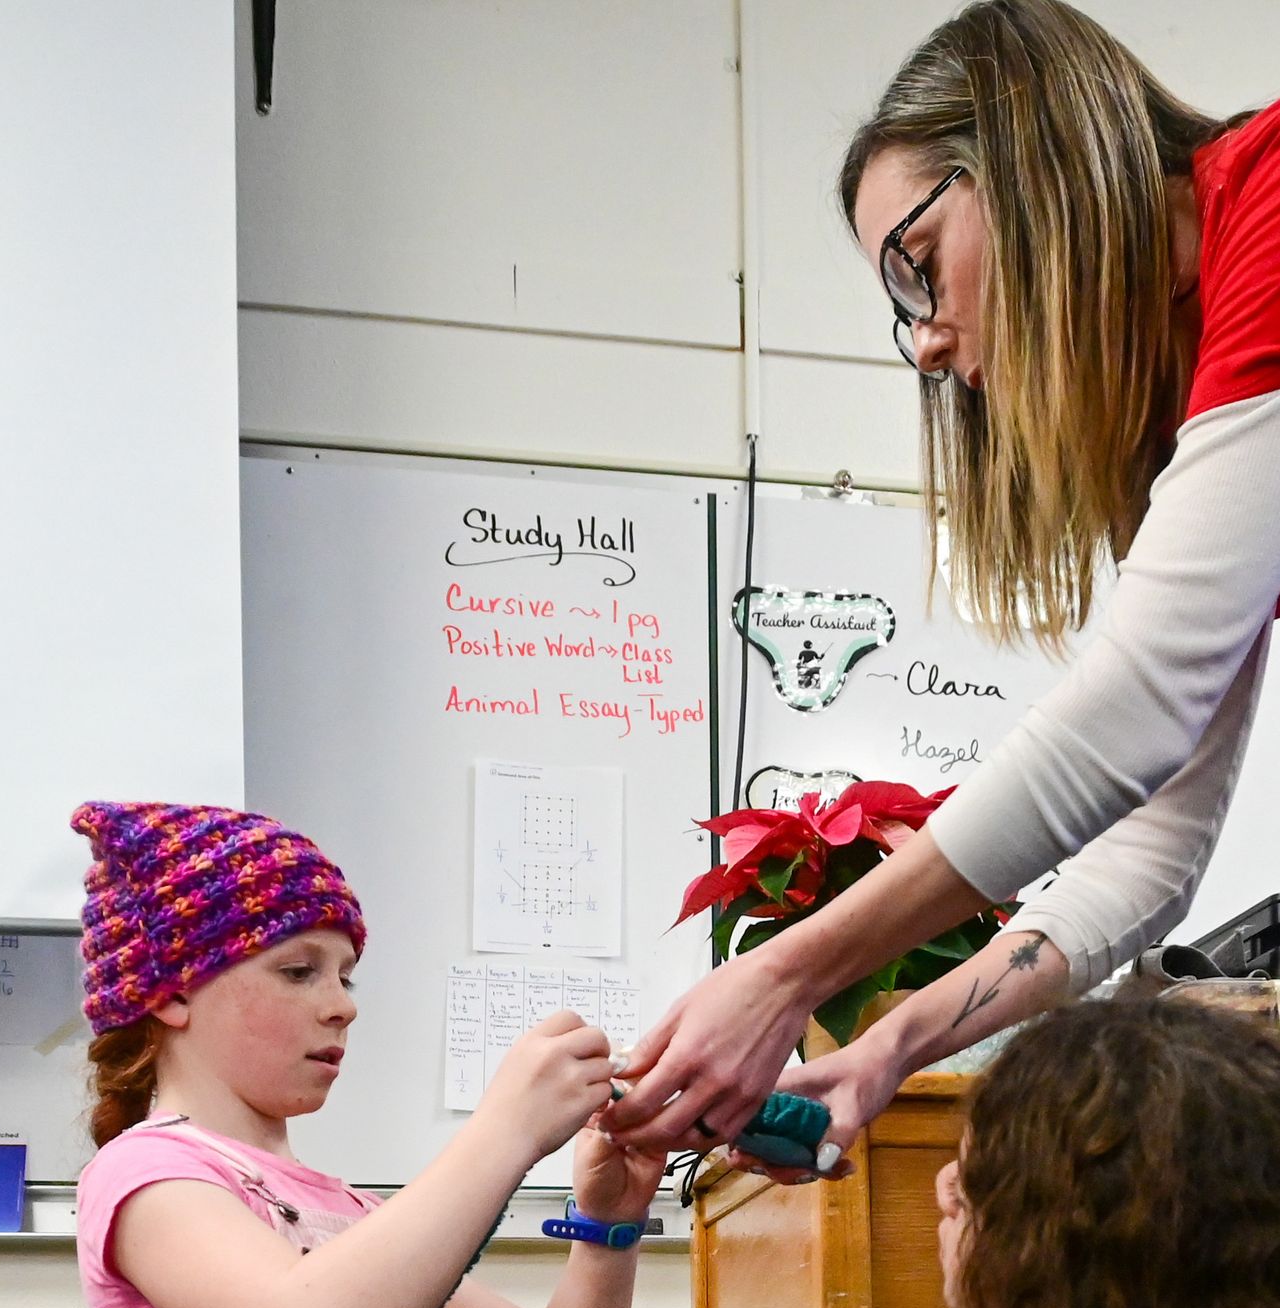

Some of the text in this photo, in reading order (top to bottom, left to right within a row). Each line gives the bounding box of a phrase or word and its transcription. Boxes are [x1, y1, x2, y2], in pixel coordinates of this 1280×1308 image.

[463, 508, 634, 566] Study Hall
[446, 583, 555, 618] Cursive
[627, 613, 660, 638] pg
[752, 612, 877, 631] Teacher Assistant
[442, 625, 673, 664] Positive Word Class
[622, 664, 664, 684] List
[907, 660, 1007, 701] Clara
[445, 686, 539, 715] Animal
[900, 726, 983, 774] Hazel
